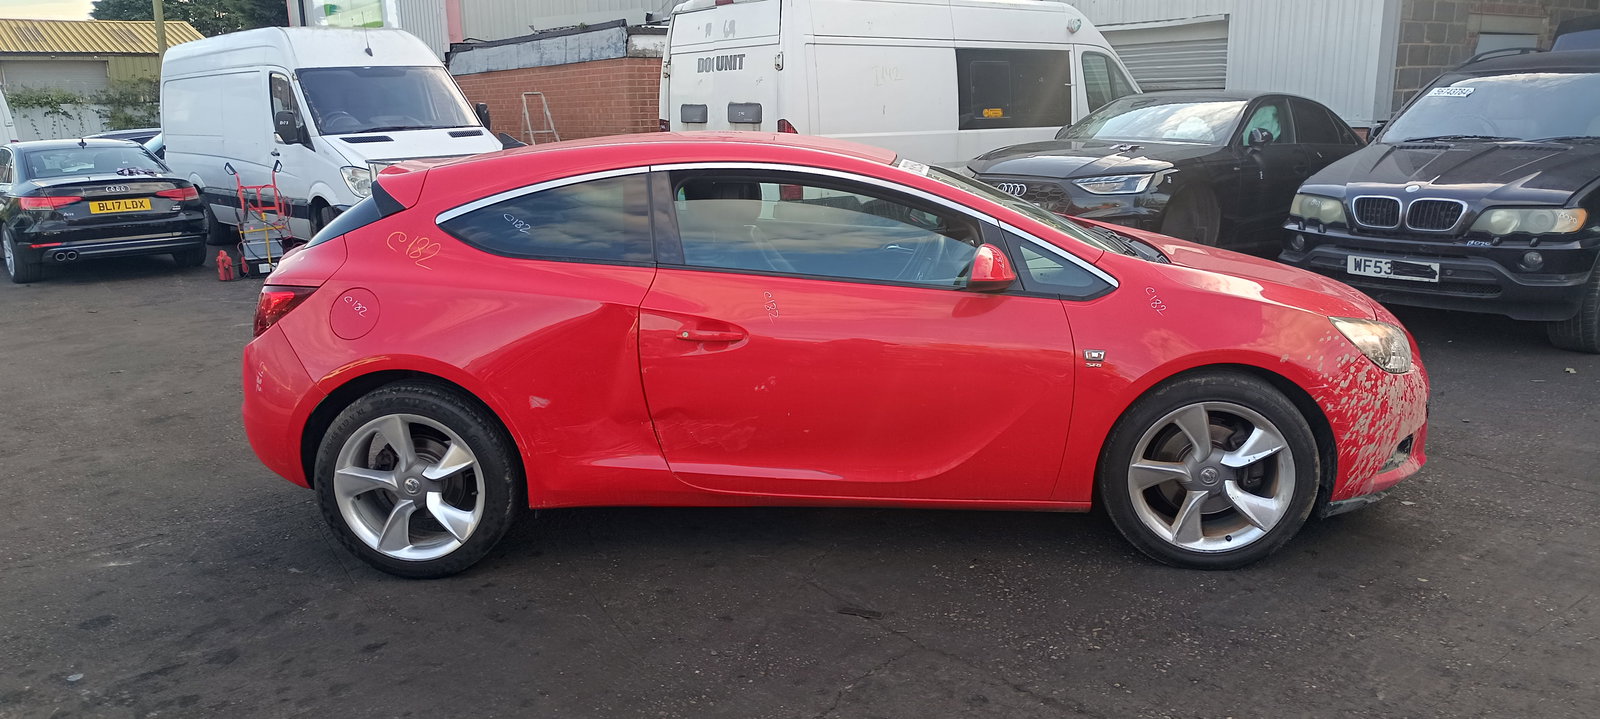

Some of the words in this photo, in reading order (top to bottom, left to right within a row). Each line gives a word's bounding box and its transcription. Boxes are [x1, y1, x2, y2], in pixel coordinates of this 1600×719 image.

[716, 54, 745, 71] UNIT
[98, 202, 121, 211] BL17
[124, 201, 146, 210] LDX
[503, 213, 531, 235] C182
[386, 231, 441, 271] C182
[1354, 257, 1393, 275] WF53
[344, 295, 367, 318] C182
[763, 291, 779, 326] C182
[1145, 286, 1167, 317] C182
